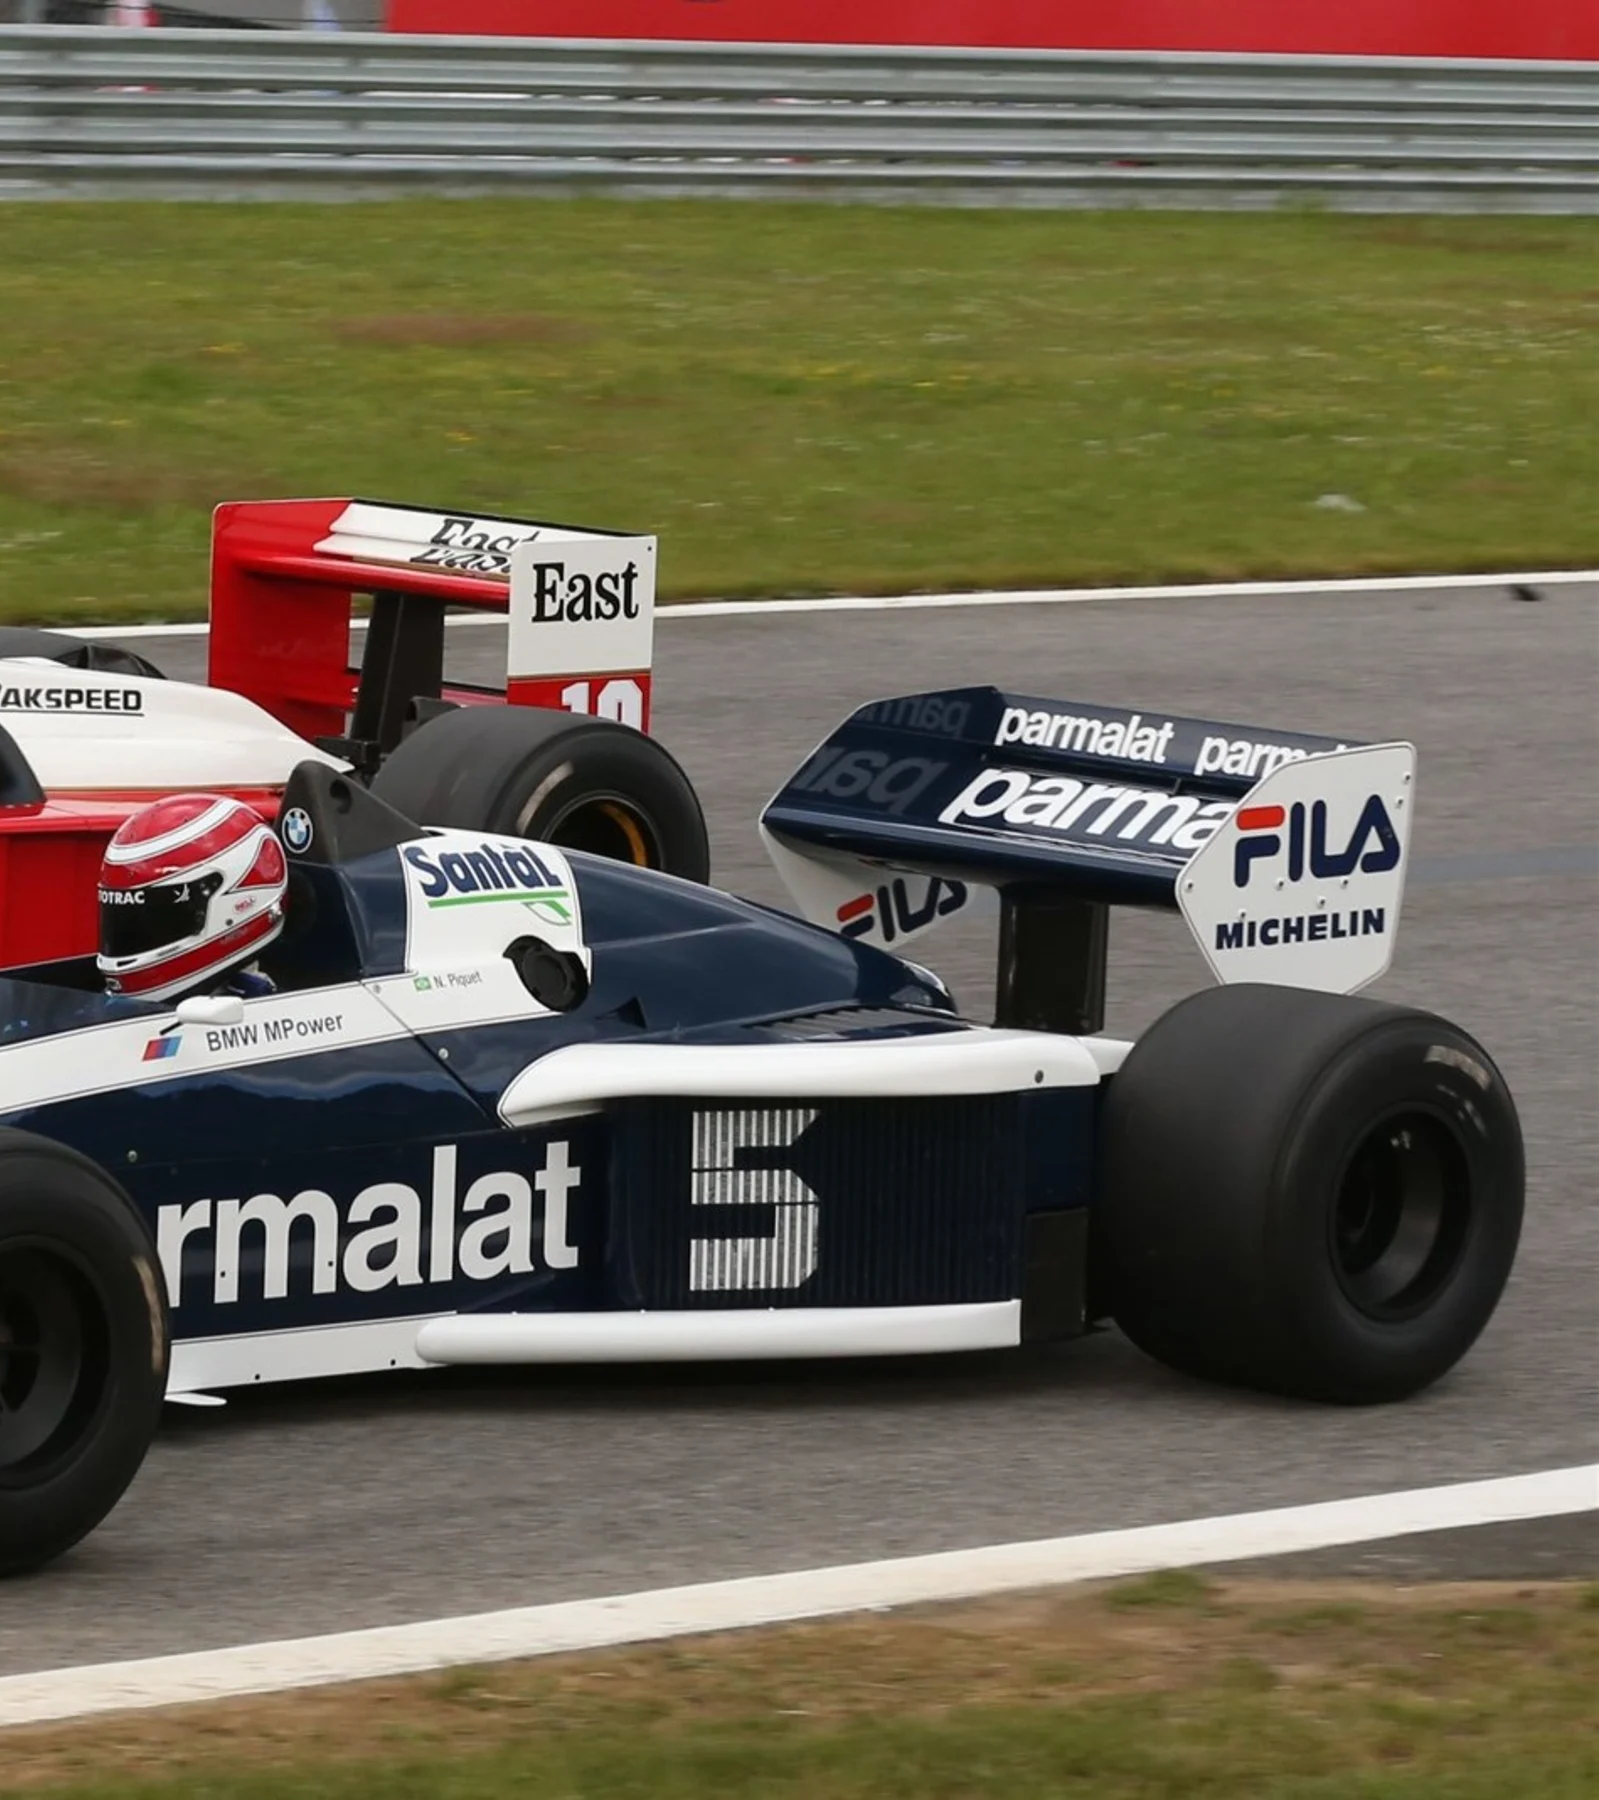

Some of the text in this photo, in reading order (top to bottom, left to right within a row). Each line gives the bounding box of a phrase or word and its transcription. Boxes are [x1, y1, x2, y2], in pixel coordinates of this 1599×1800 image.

[531, 561, 639, 623] East
[561, 679, 643, 733] 10
[995, 704, 1177, 766] parmalat
[1235, 793, 1401, 889] FILA
[836, 876, 968, 943] FILA
[1215, 907, 1386, 951] MICHELIN
[447, 970, 483, 989] Piquet
[206, 1014, 344, 1052] BMW MPower
[156, 1140, 582, 1308] rmalat
[689, 1109, 821, 1291] 5
